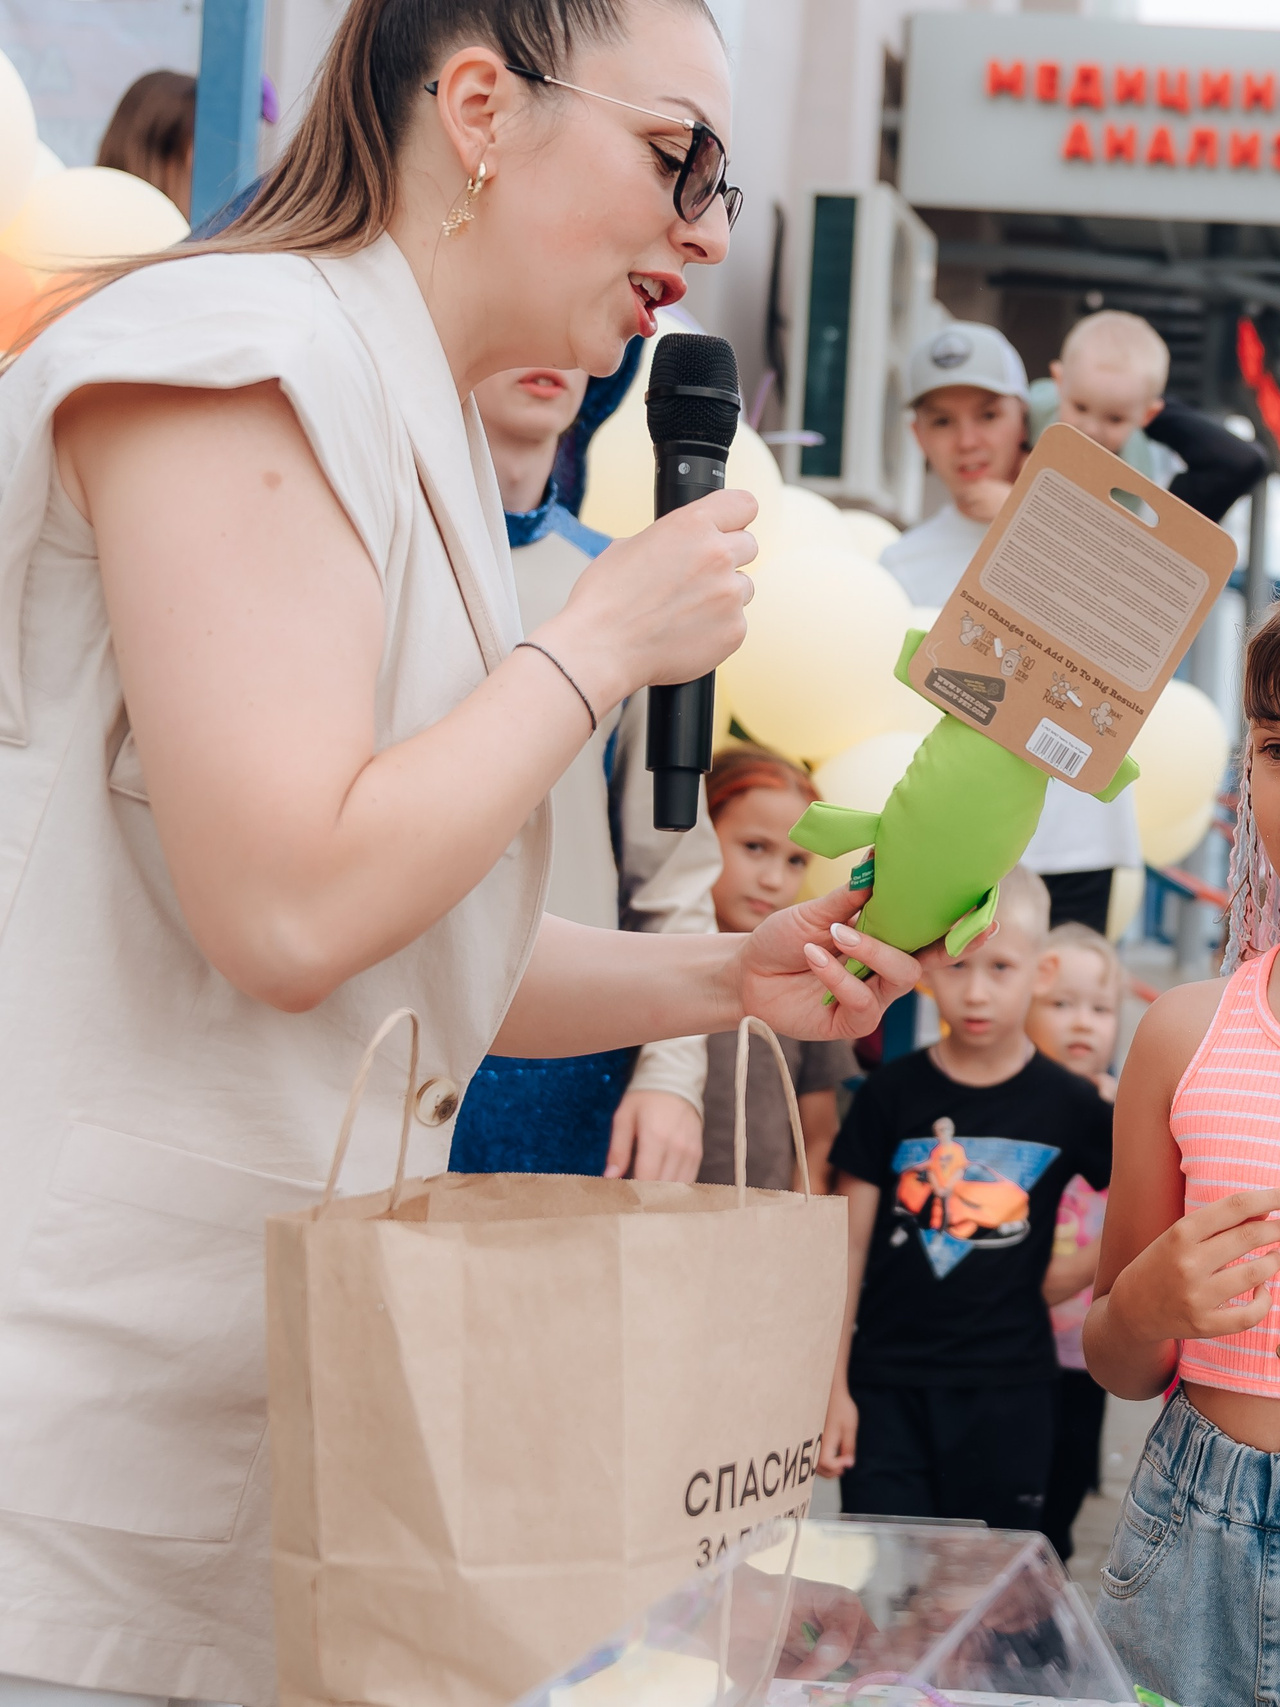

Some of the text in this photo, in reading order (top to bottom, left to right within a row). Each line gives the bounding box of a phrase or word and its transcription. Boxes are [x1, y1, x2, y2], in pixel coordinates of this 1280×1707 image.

[960, 590, 1145, 715] Small Changes Can Add Up To Big Results
[1042, 688, 1067, 711] REUSE
[685, 1433, 823, 1516] СПАСИБО
[696, 1532, 729, 1568] ЗА
